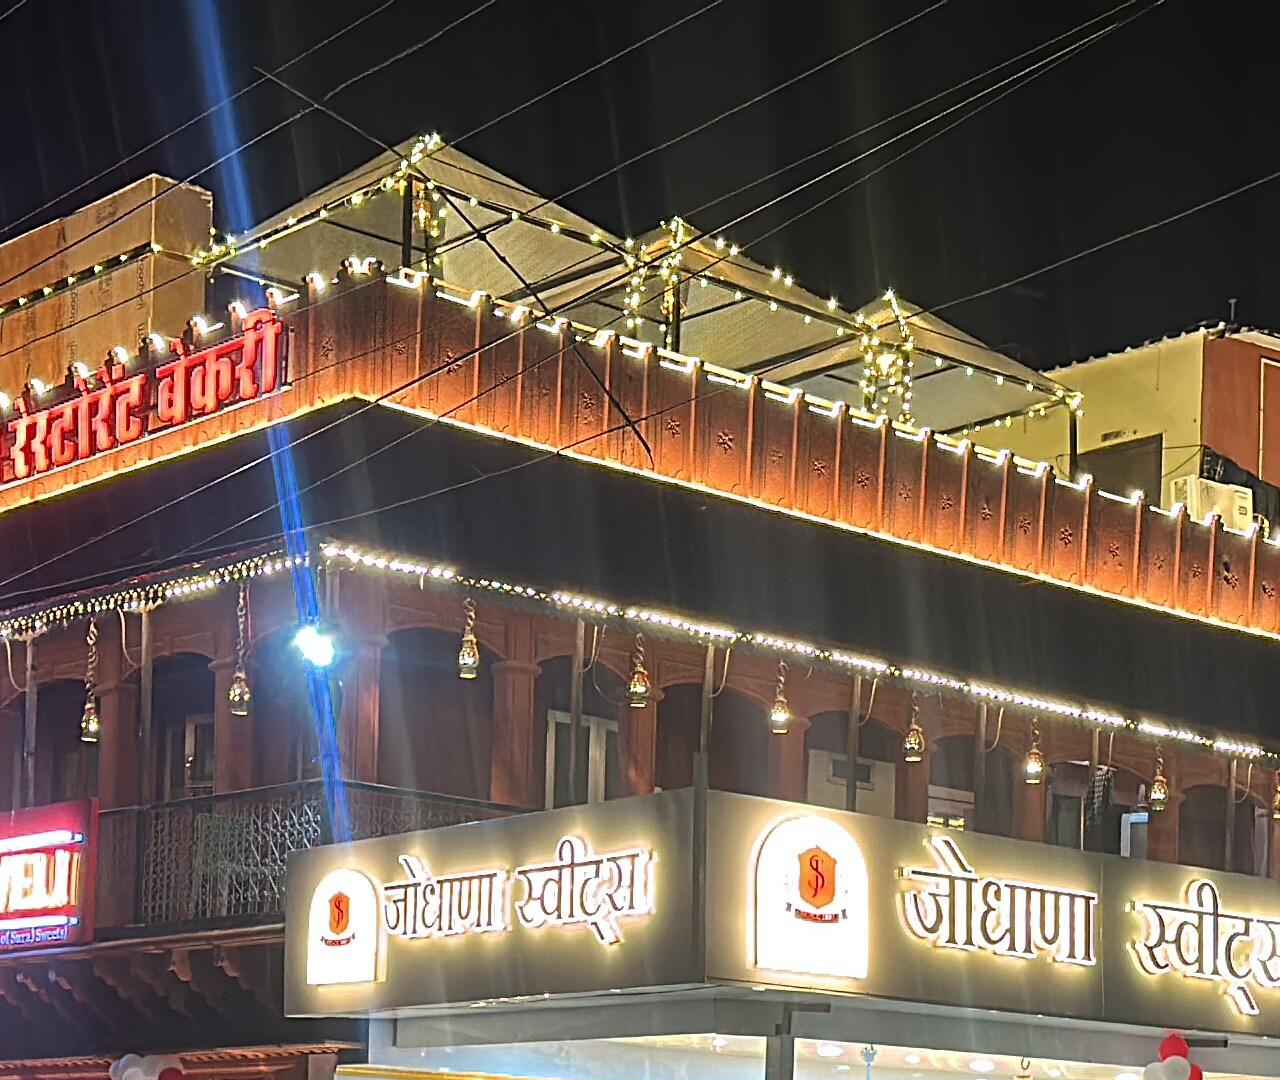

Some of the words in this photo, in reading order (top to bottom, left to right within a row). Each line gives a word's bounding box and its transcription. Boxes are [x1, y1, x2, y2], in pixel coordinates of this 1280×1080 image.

[155, 307, 283, 426] बेकरी
[0, 930, 10, 945] of
[10, 927, 35, 944] Suraj
[384, 854, 510, 939] जोधाणा
[515, 836, 656, 945] स्वीट्स
[897, 835, 1098, 966] जोधाणा
